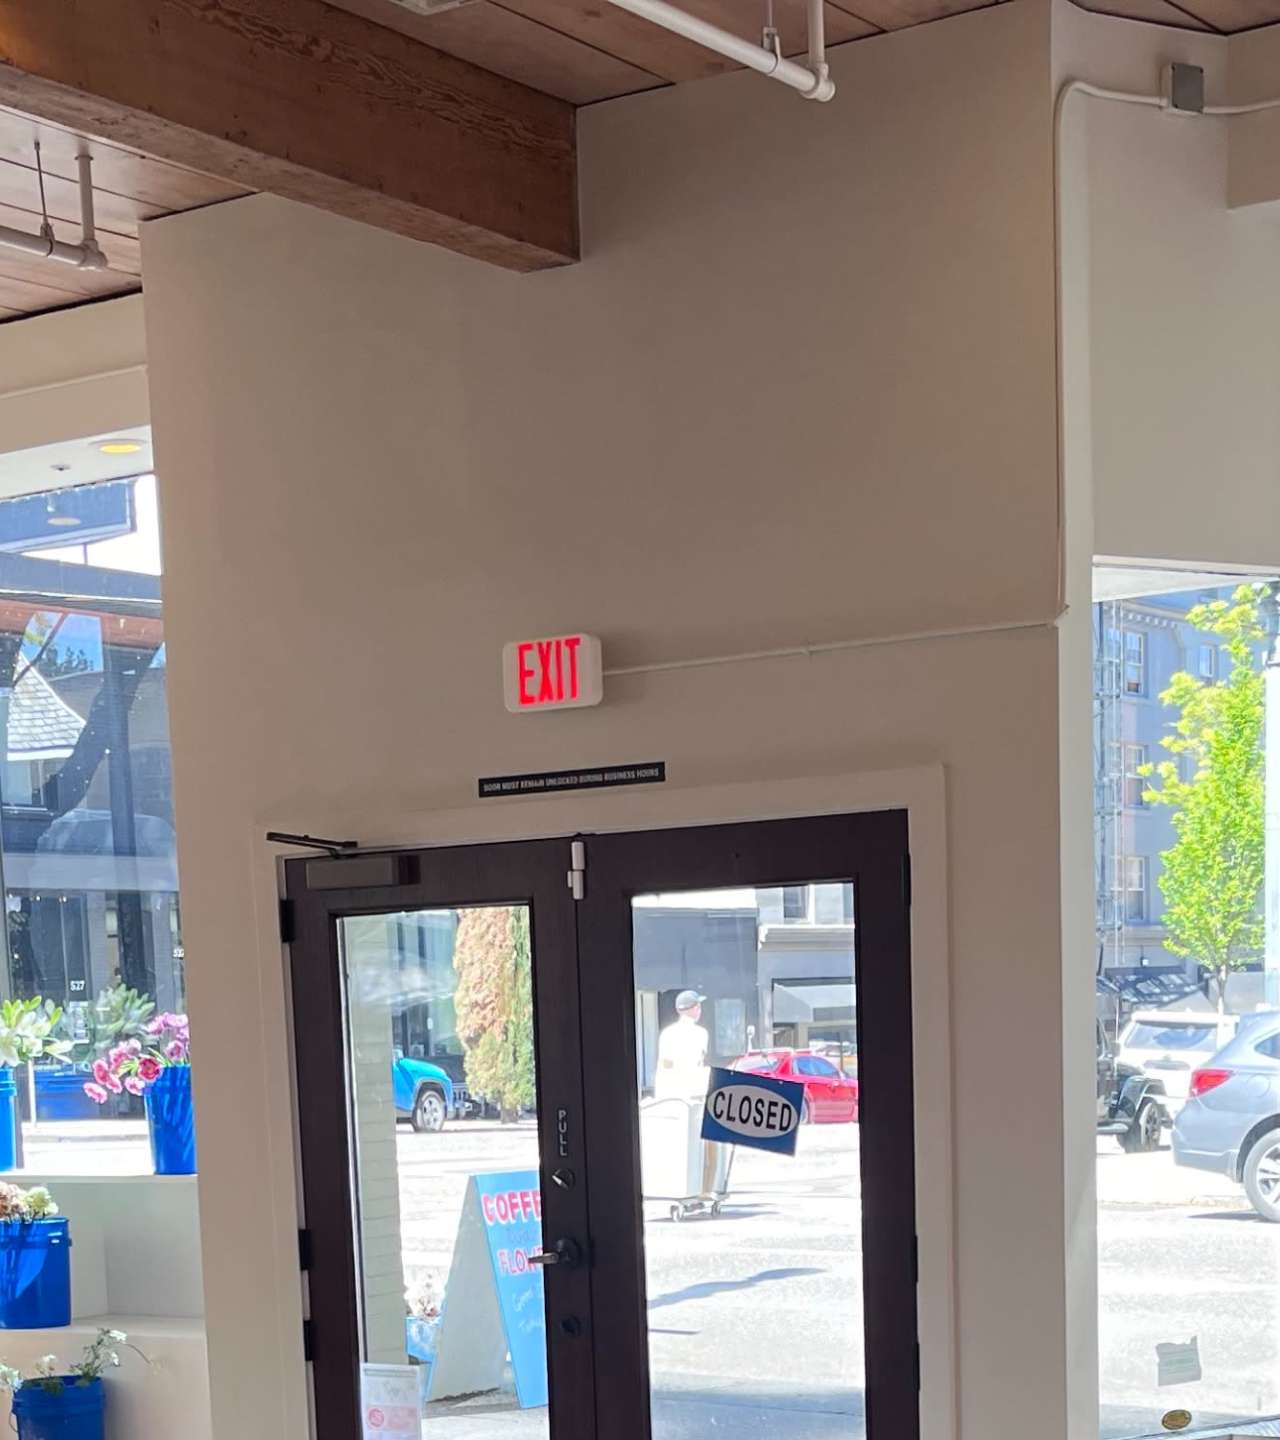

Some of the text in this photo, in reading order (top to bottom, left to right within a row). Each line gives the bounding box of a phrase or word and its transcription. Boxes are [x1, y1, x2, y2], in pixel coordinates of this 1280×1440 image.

[517, 637, 581, 705] EXIT
[637, 767, 659, 778] HOURS
[558, 1110, 568, 1156] PULL
[713, 1091, 793, 1132] CLOSED
